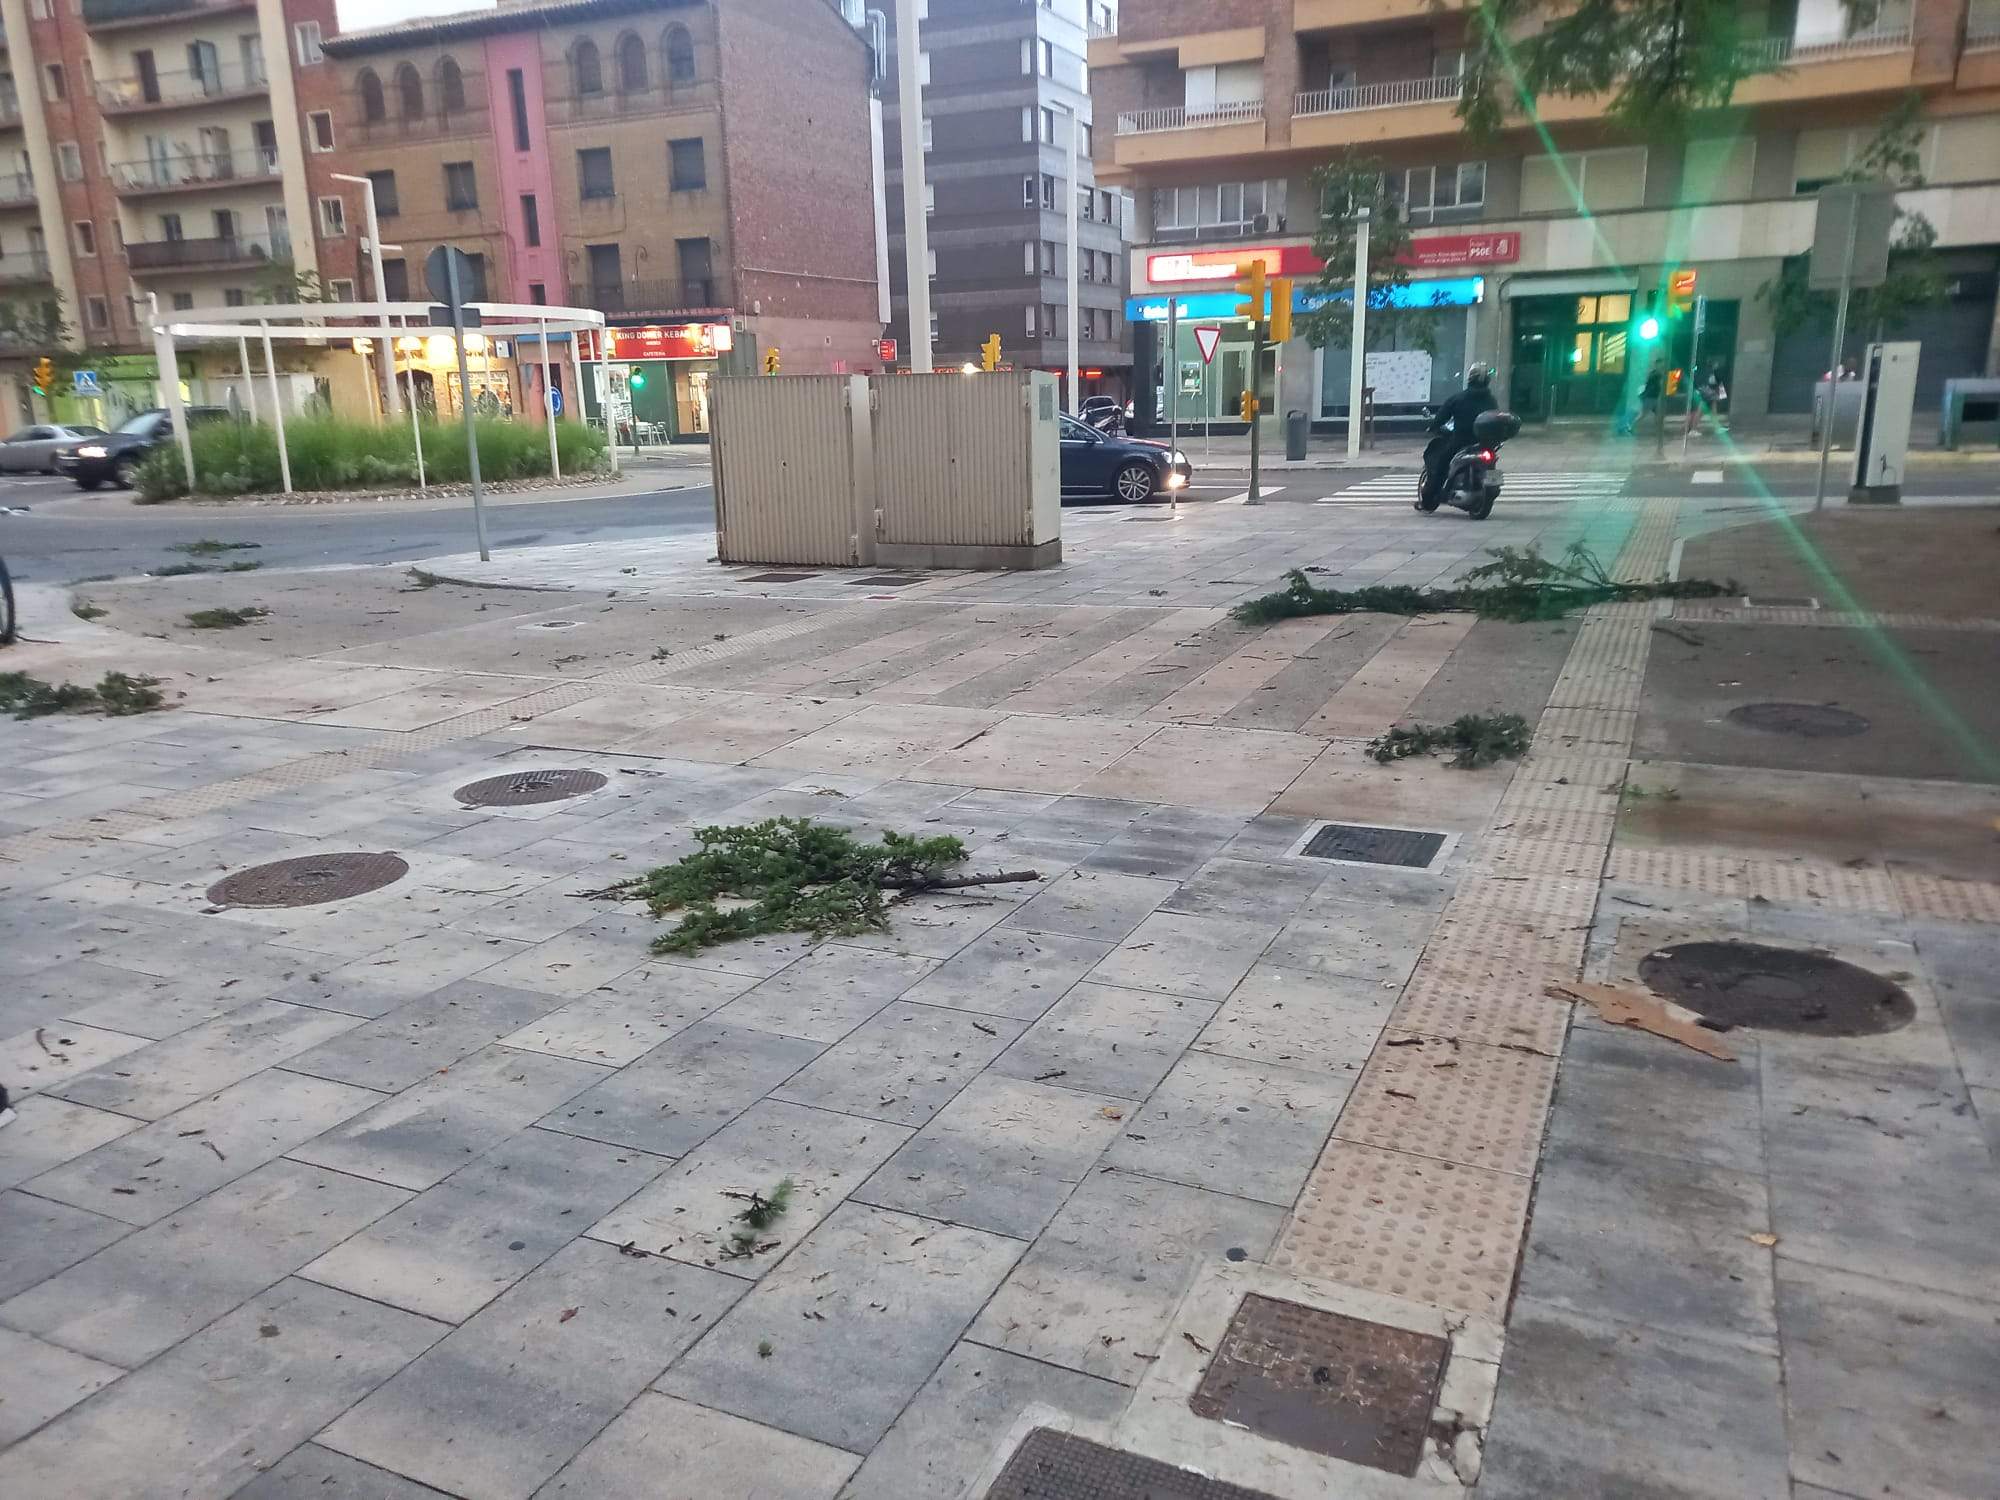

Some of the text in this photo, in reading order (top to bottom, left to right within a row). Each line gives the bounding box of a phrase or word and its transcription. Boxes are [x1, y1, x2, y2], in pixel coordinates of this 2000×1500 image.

[1470, 247, 1491, 258] PSOE
[1143, 304, 1188, 319] Sabaell
[616, 332, 635, 340] KING
